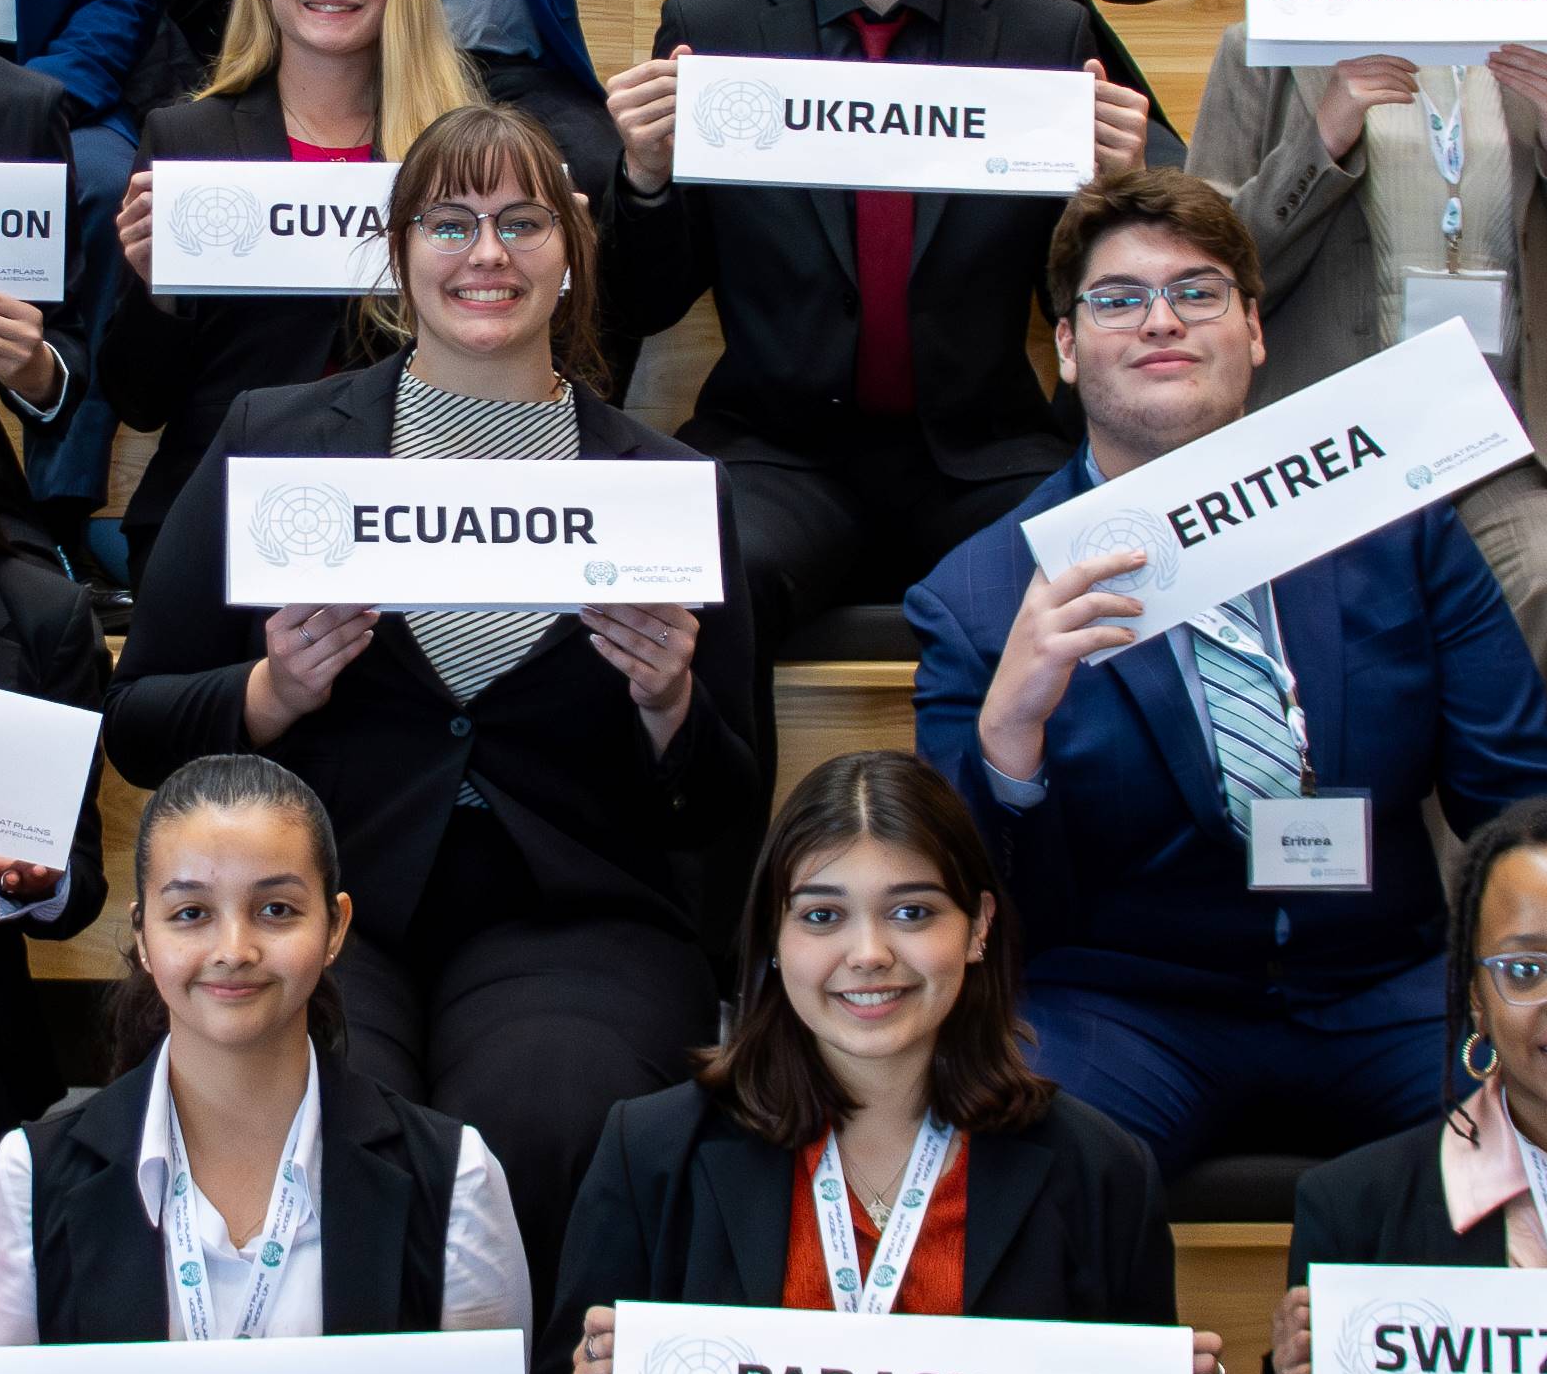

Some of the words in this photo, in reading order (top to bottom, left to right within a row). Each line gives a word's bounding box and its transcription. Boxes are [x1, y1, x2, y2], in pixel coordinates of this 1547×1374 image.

[784, 98, 986, 139] UKRAINE
[269, 203, 393, 238] GUYA
[1166, 425, 1386, 549] ERITREA
[353, 504, 597, 545] ECUADOR
[661, 566, 703, 574] PLAINS
[13, 822, 52, 837] PLAINS
[1281, 836, 1332, 847] Eritrea
